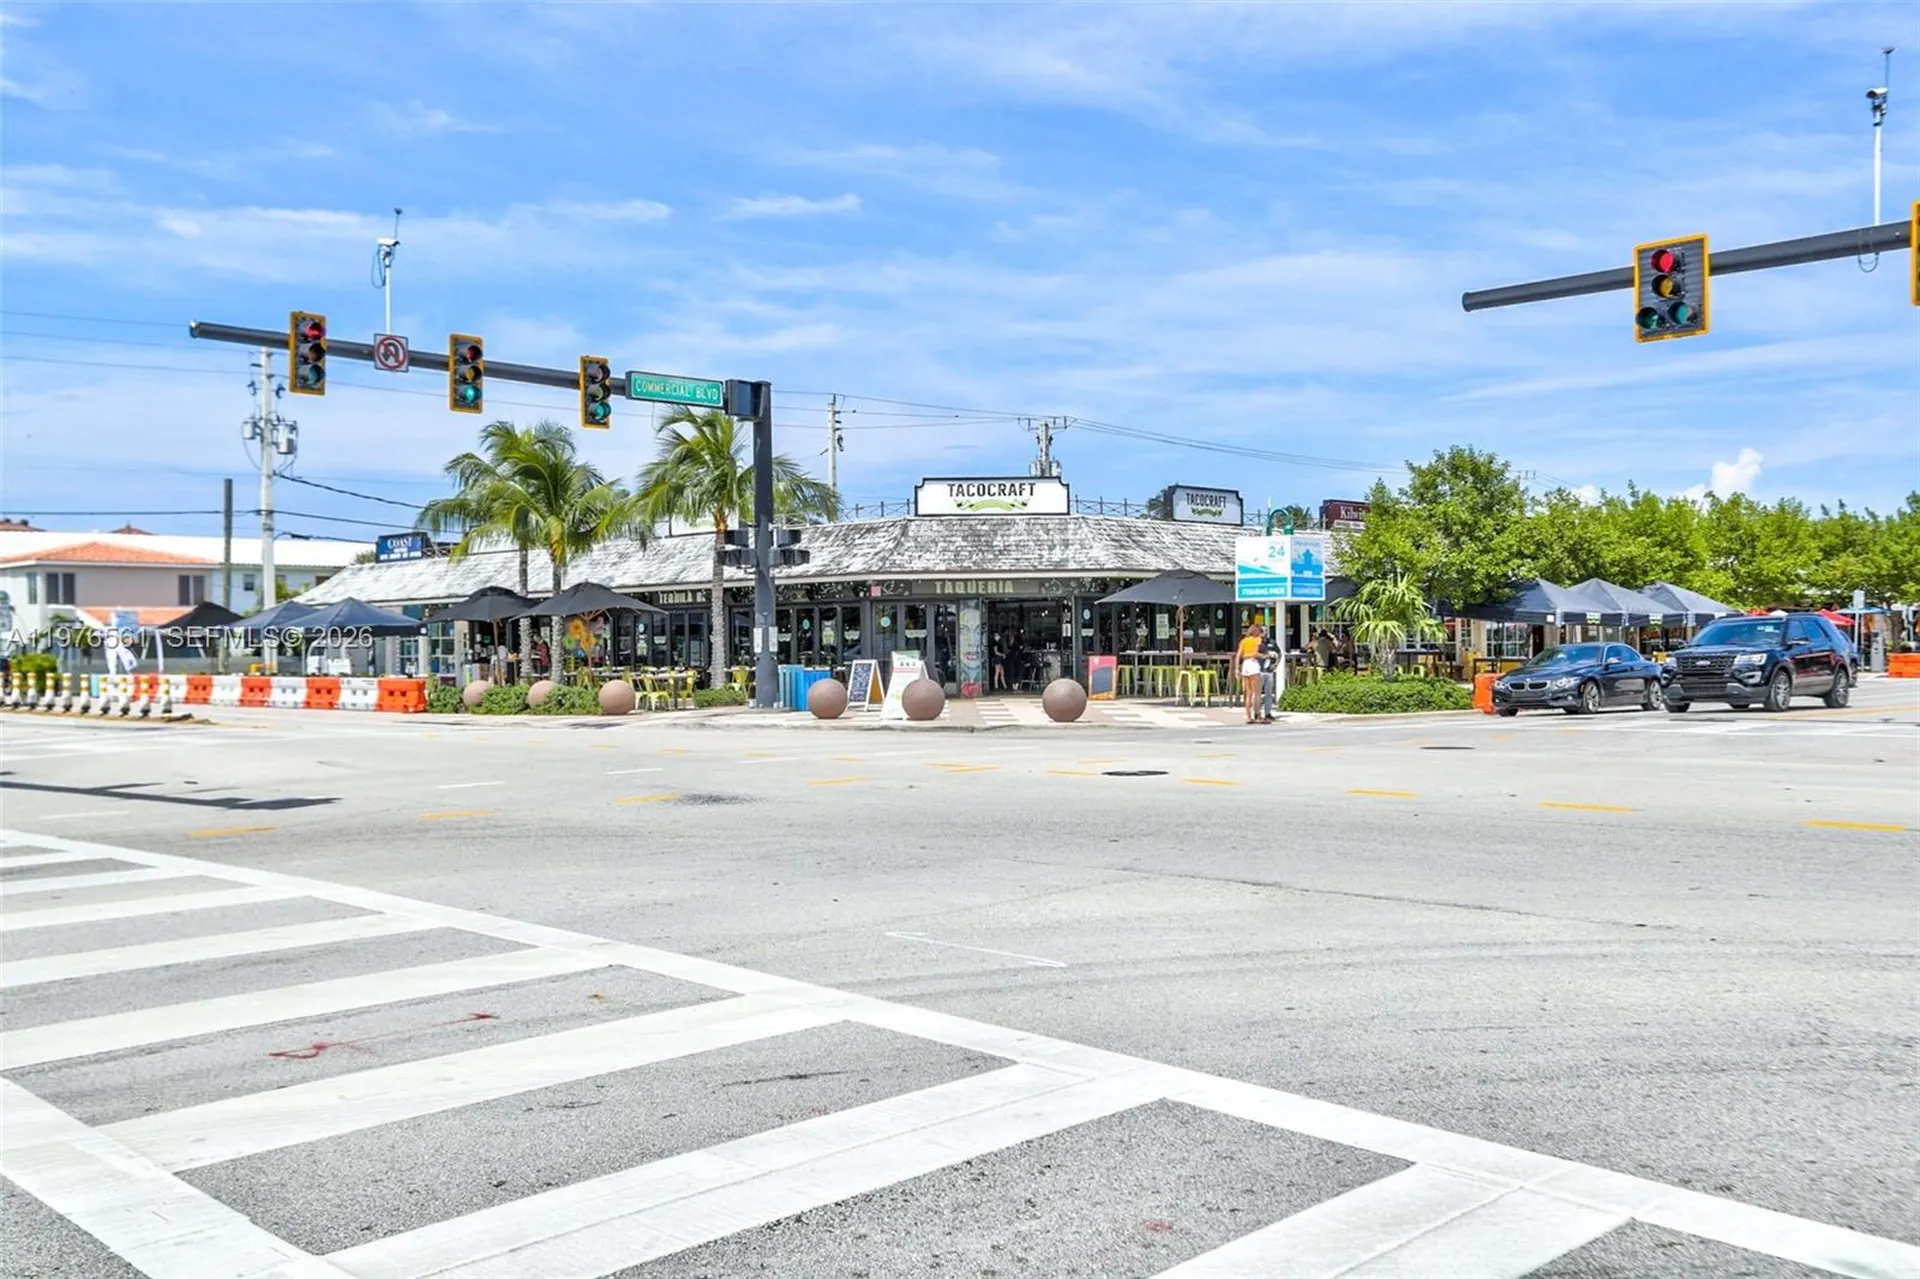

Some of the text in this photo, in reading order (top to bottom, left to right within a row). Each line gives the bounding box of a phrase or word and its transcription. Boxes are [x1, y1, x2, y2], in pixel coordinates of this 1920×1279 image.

[635, 379, 719, 400] COMMERCIAL BLVD
[947, 482, 1036, 498] TACOCRAFT
[1186, 492, 1227, 509] TACOCRAFT
[934, 580, 1014, 595] TAQUERIA
[658, 591, 693, 604] TEQUILA
